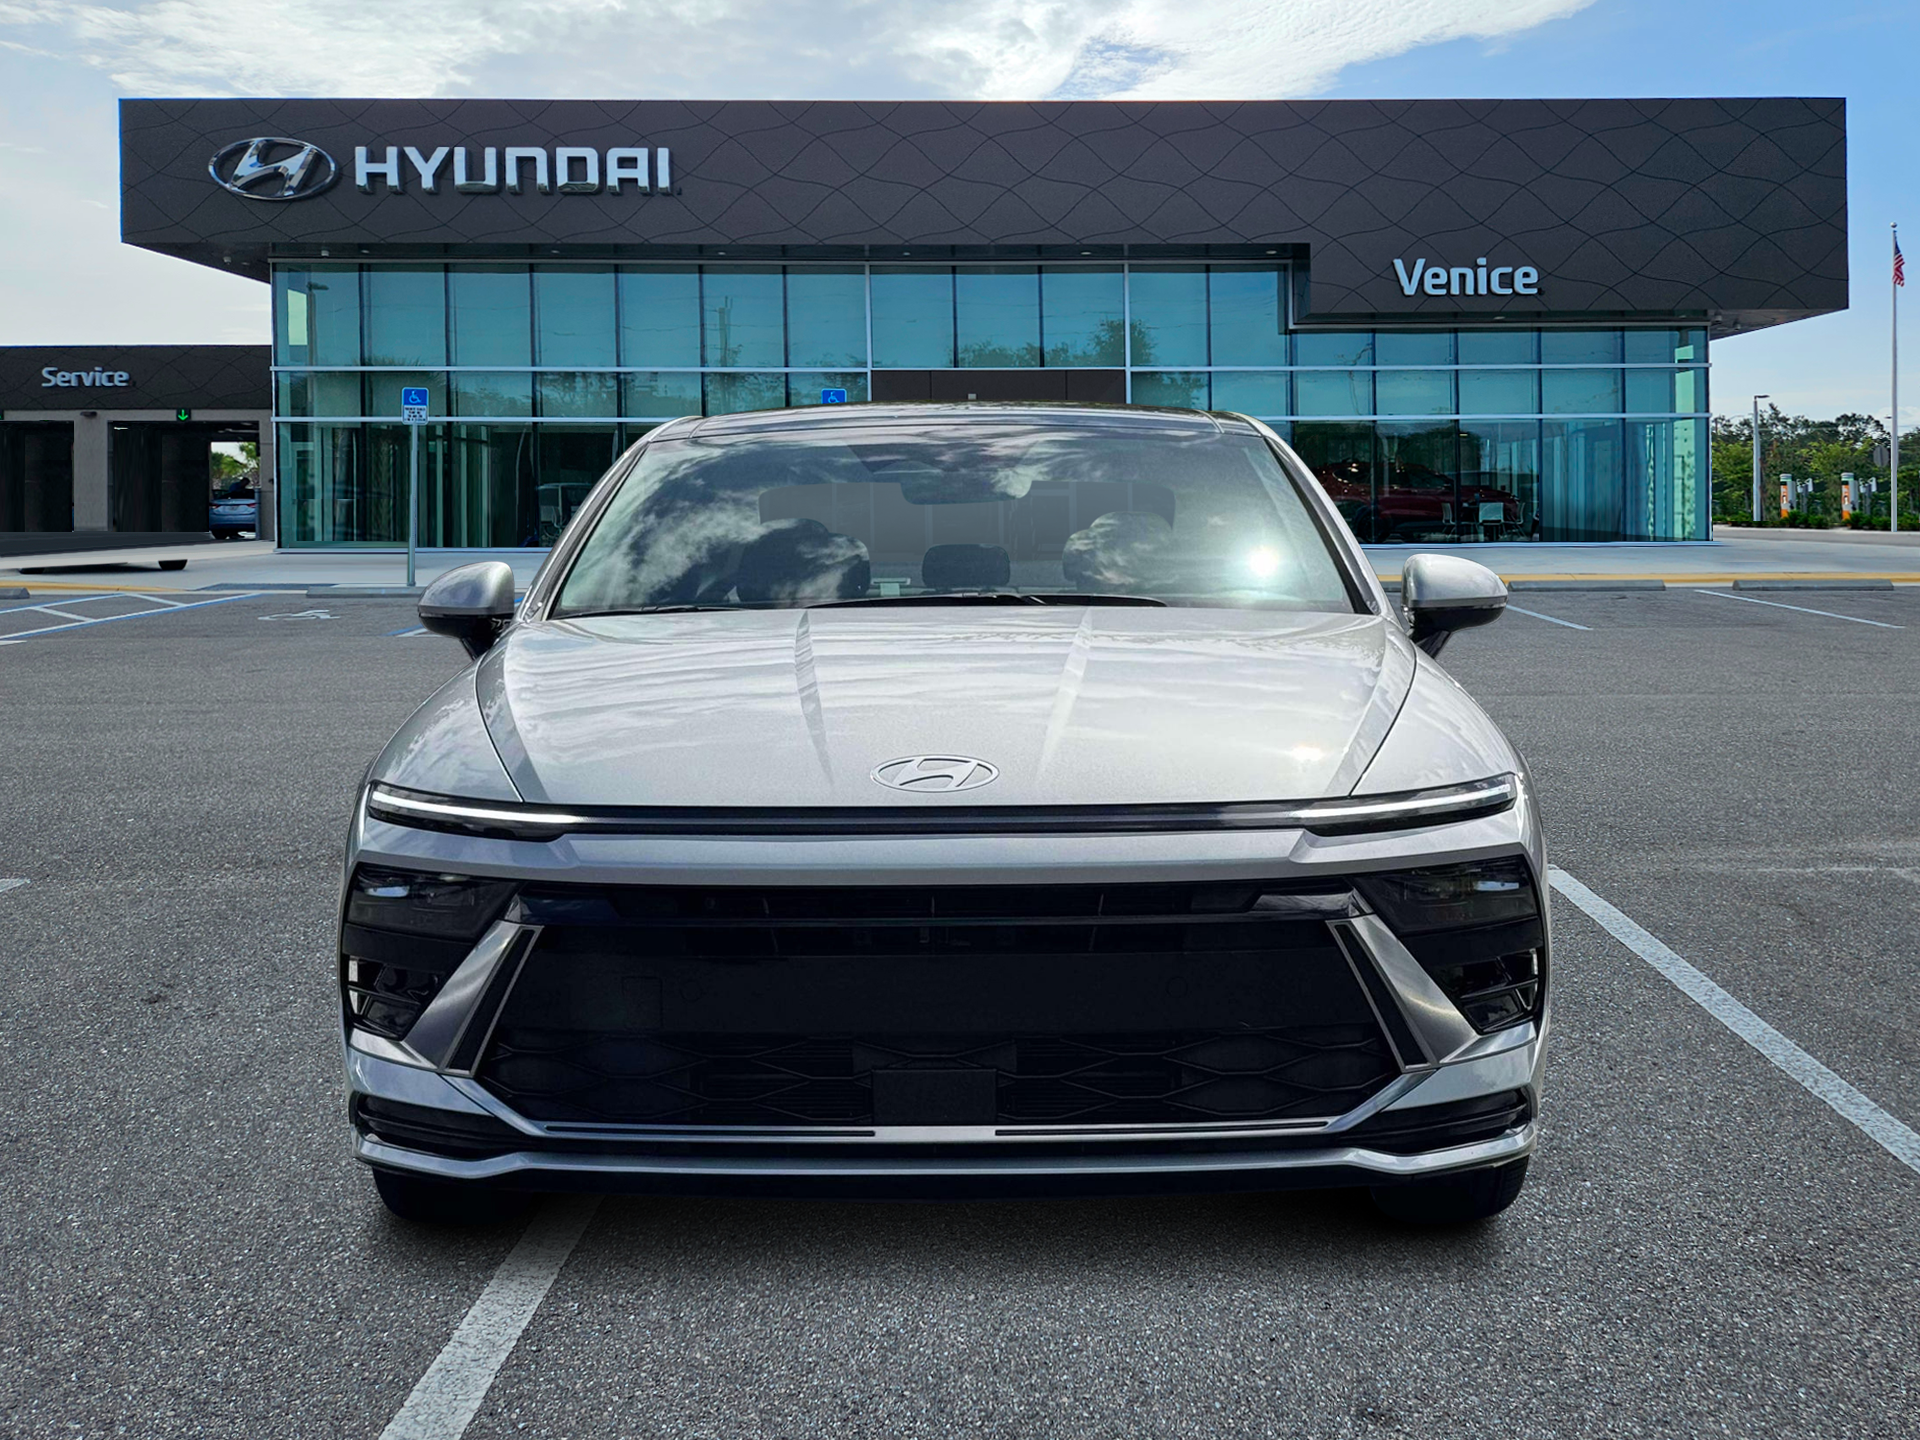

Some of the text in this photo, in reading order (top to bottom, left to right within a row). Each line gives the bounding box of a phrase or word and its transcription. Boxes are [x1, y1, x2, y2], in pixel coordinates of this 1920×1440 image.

[354, 146, 671, 193] HYUNDAI
[1393, 257, 1539, 296] Venice
[41, 366, 130, 387] Service
